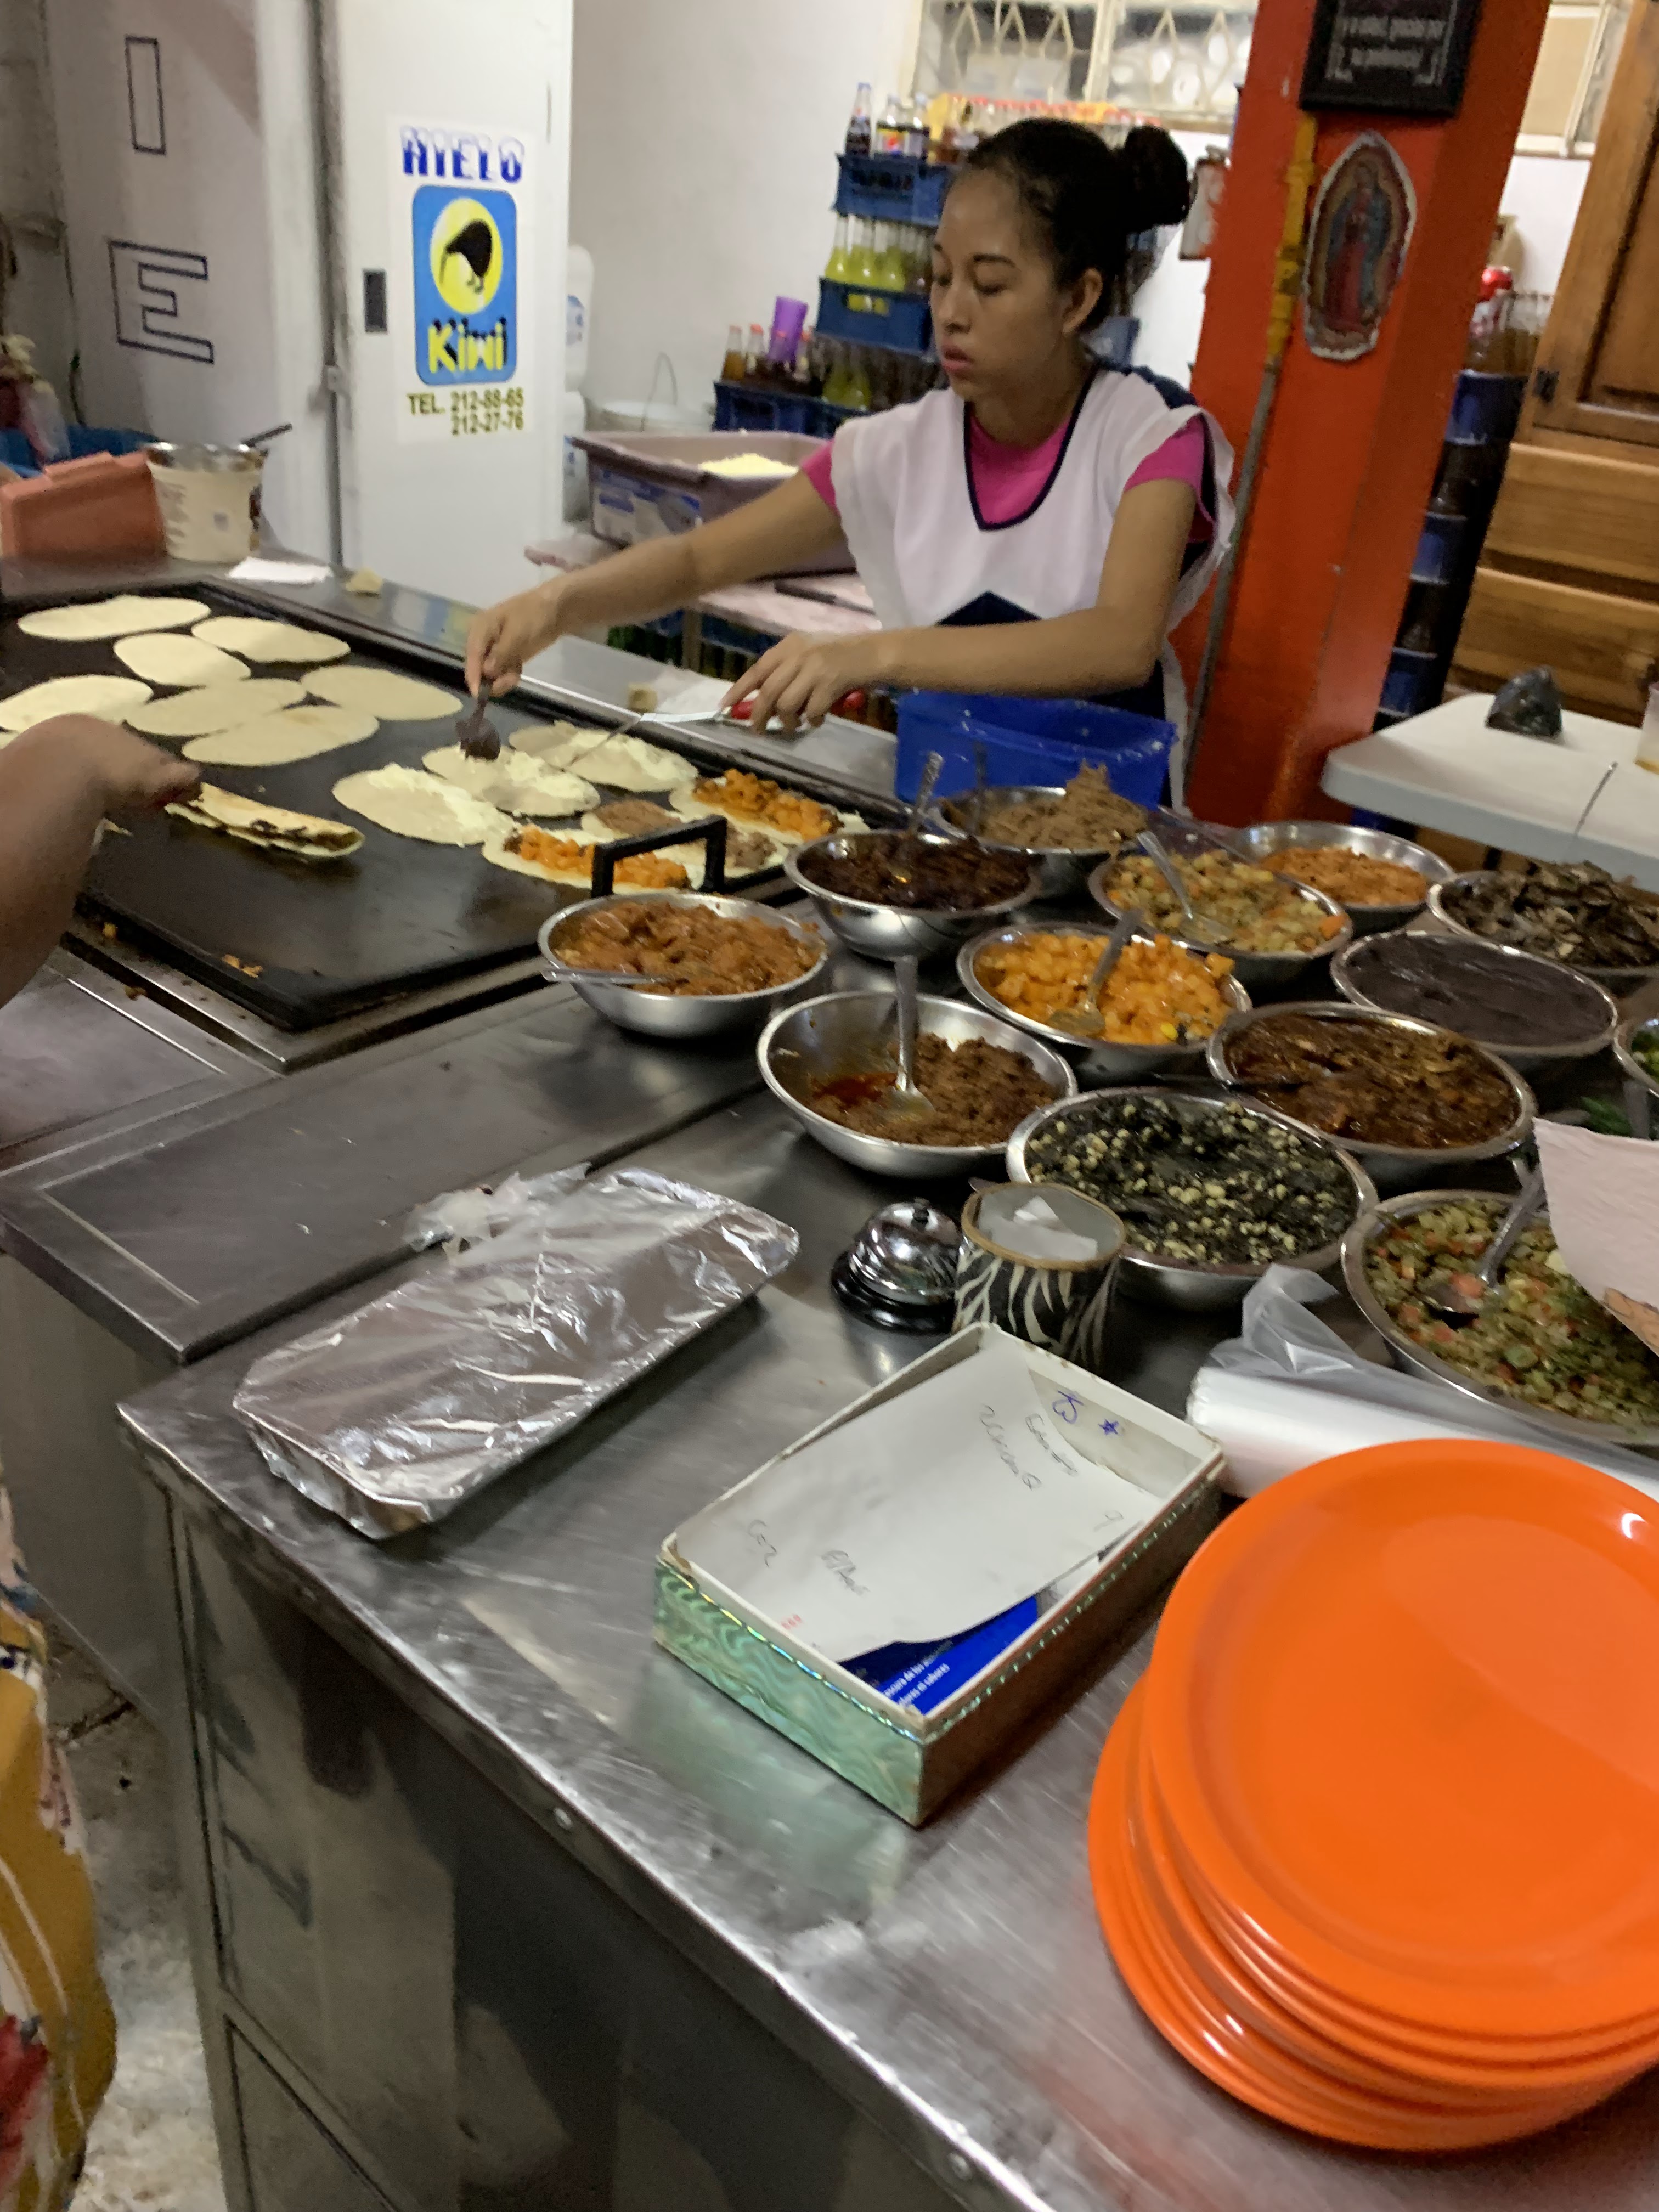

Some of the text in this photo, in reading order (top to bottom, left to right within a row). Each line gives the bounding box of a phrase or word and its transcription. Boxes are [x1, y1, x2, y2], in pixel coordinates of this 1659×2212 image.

[400, 126, 525, 183] HIELO
[428, 318, 507, 374] Kiwi
[407, 391, 446, 415] TEL.
